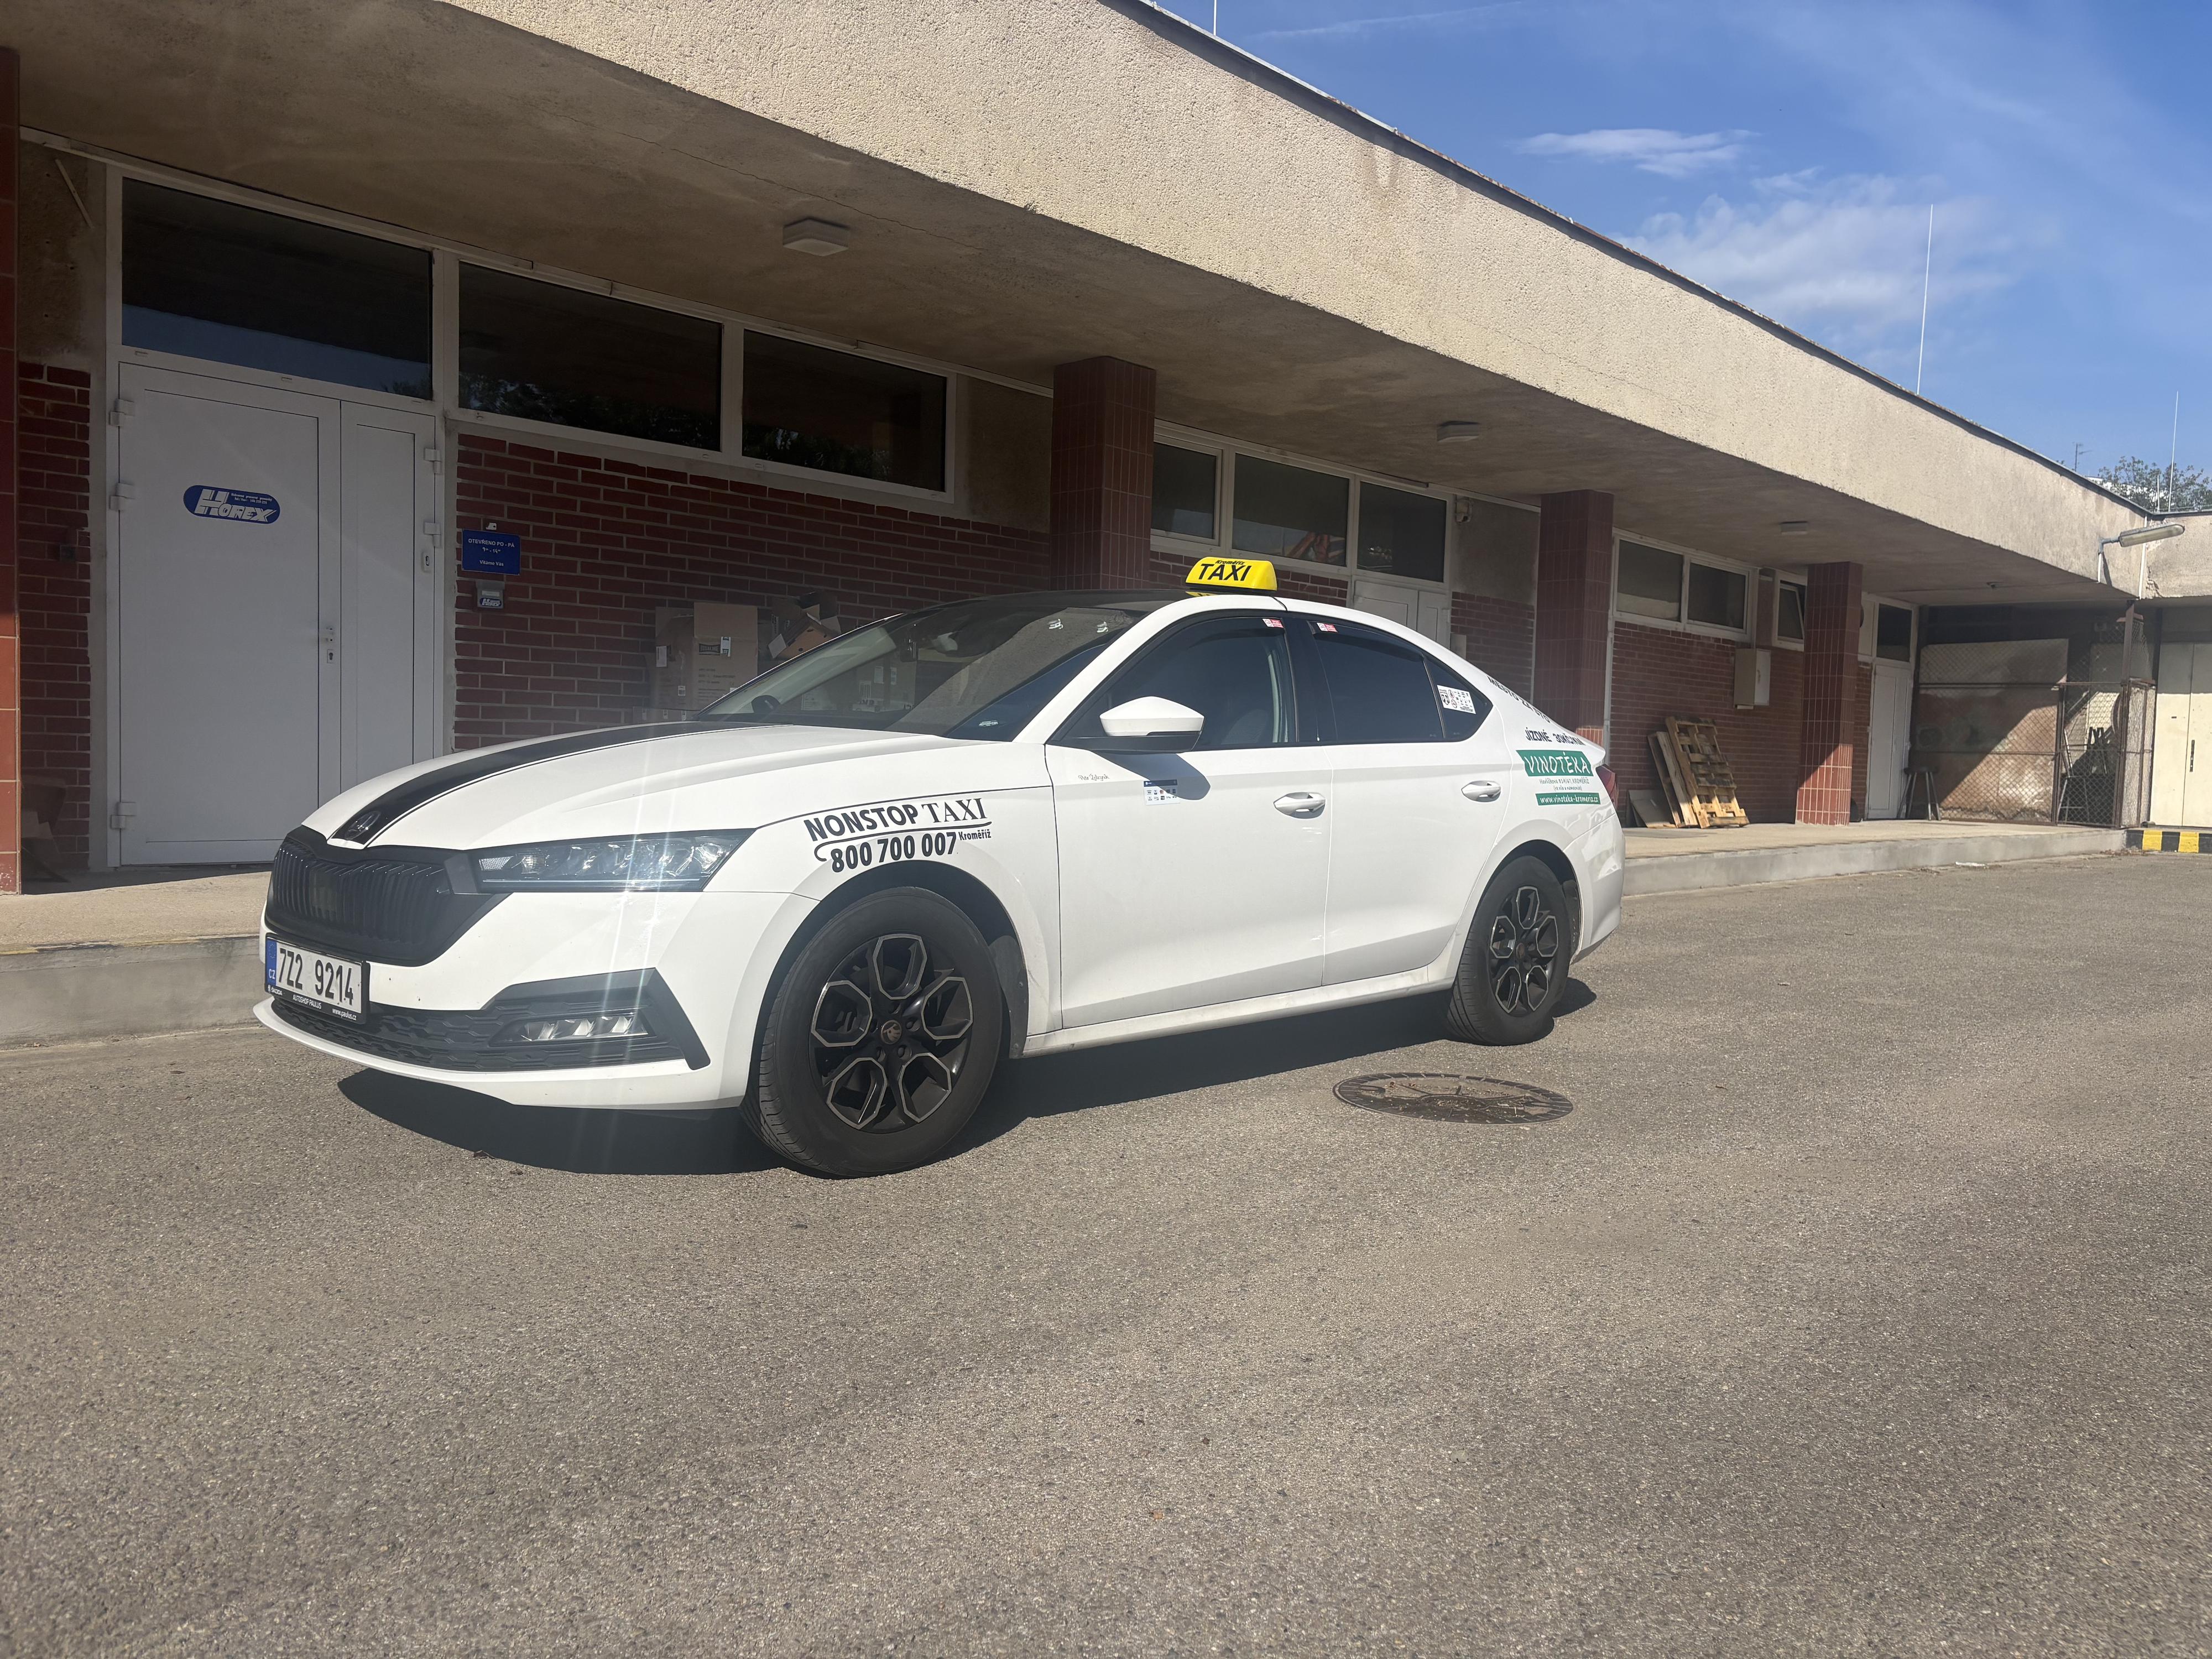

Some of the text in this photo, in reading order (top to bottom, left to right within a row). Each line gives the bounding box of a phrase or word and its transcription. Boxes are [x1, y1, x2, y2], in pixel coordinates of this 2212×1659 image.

[194, 489, 276, 522] HOREX
[1198, 564, 1252, 581] TAXI
[1525, 727, 1552, 742] JÍZDNÉ
[1524, 752, 1591, 774] VINOTÉKA
[1540, 795, 1598, 804] www.vinoteka-kromeriz.cz
[804, 798, 988, 842] NONSTOP TAXI
[831, 829, 992, 873] 800 700 007 Kroměříž
[269, 969, 275, 979] CZ
[279, 948, 353, 1005] 7Z2 9214
[293, 994, 322, 1009] AUTOSHOP PAULUS
[332, 1008, 357, 1021] www.paulus.cz
